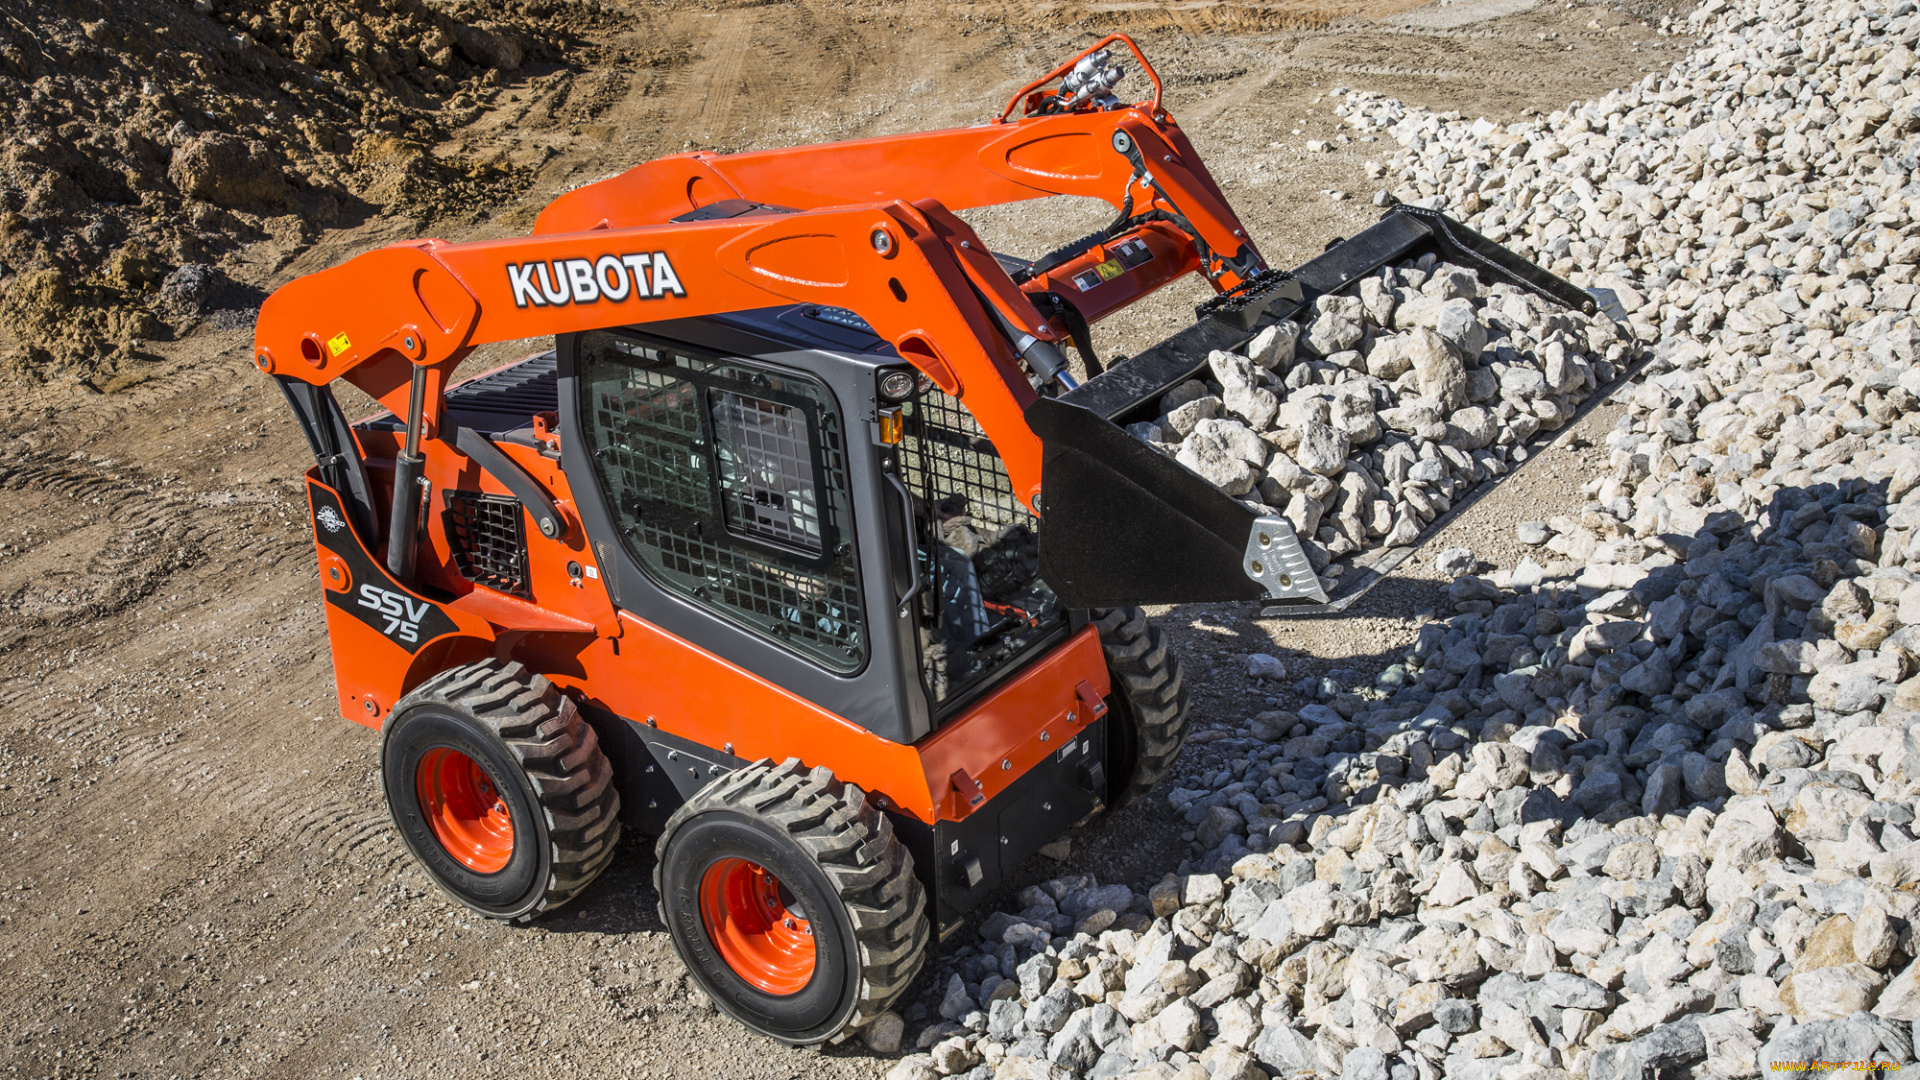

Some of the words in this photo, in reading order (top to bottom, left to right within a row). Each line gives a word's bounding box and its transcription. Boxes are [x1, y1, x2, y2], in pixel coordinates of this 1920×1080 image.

[506, 251, 687, 308] KUBOTA
[358, 584, 430, 623] SSV
[382, 614, 419, 643] 75
